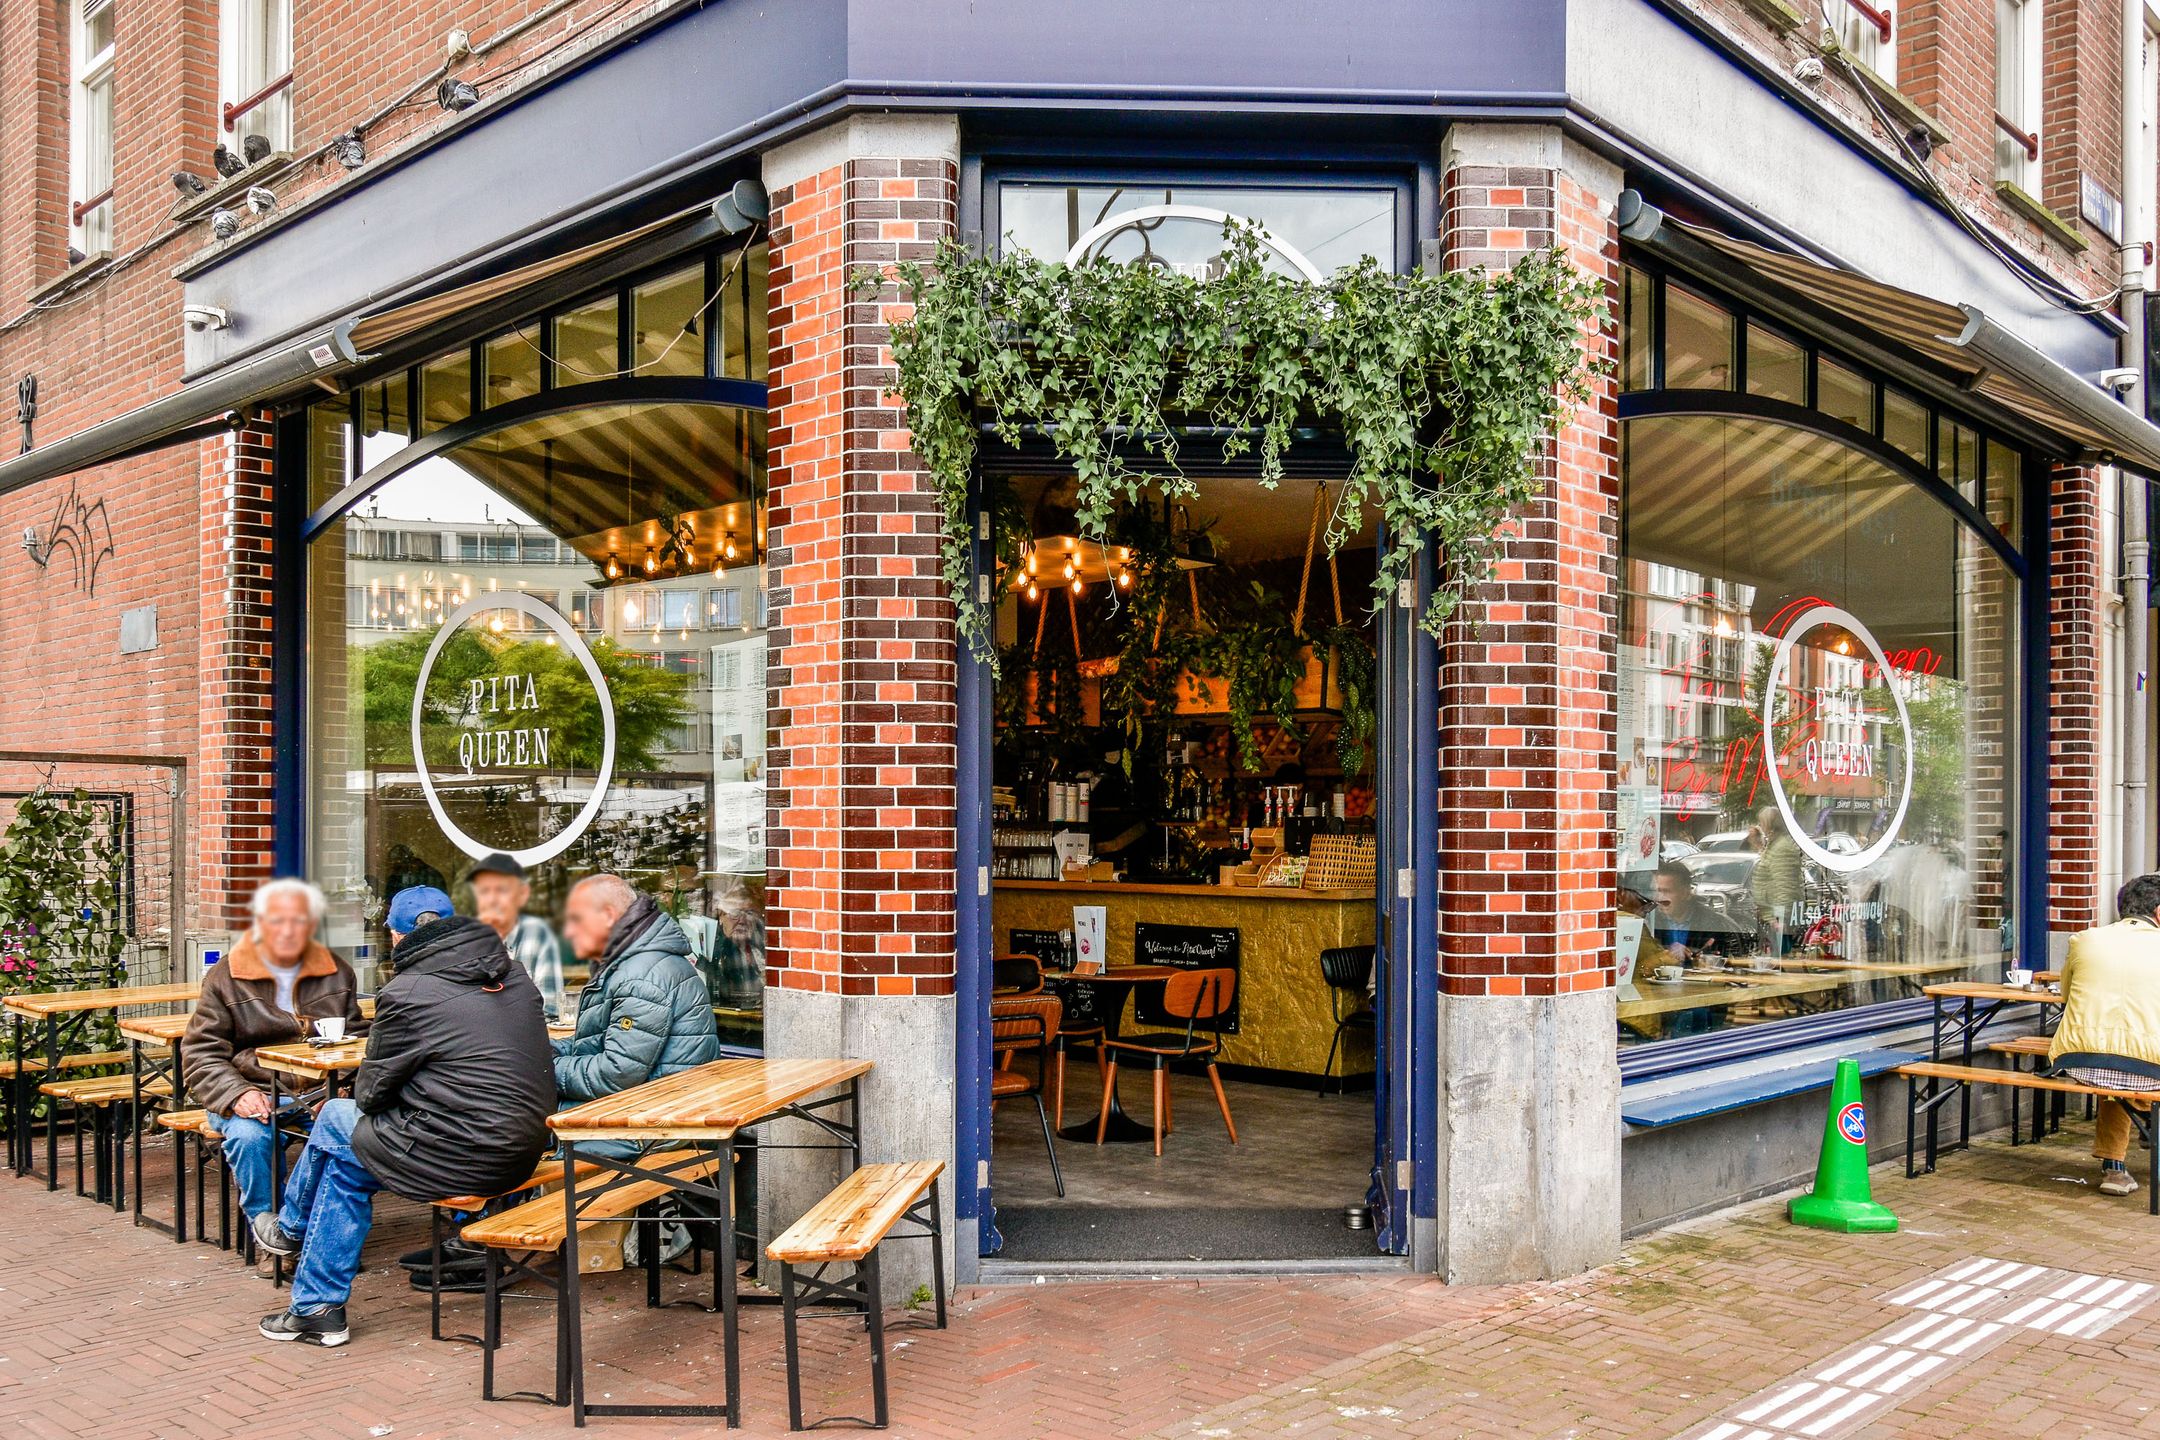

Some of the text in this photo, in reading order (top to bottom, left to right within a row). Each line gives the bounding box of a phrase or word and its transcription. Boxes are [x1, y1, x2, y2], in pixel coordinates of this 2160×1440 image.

[470, 672, 539, 714] PITA
[1814, 686, 1867, 726] PITA
[460, 728, 549, 776] QUEEN
[1806, 739, 1873, 782] QUEEN
[1789, 895, 1889, 926] Also takeaway!
